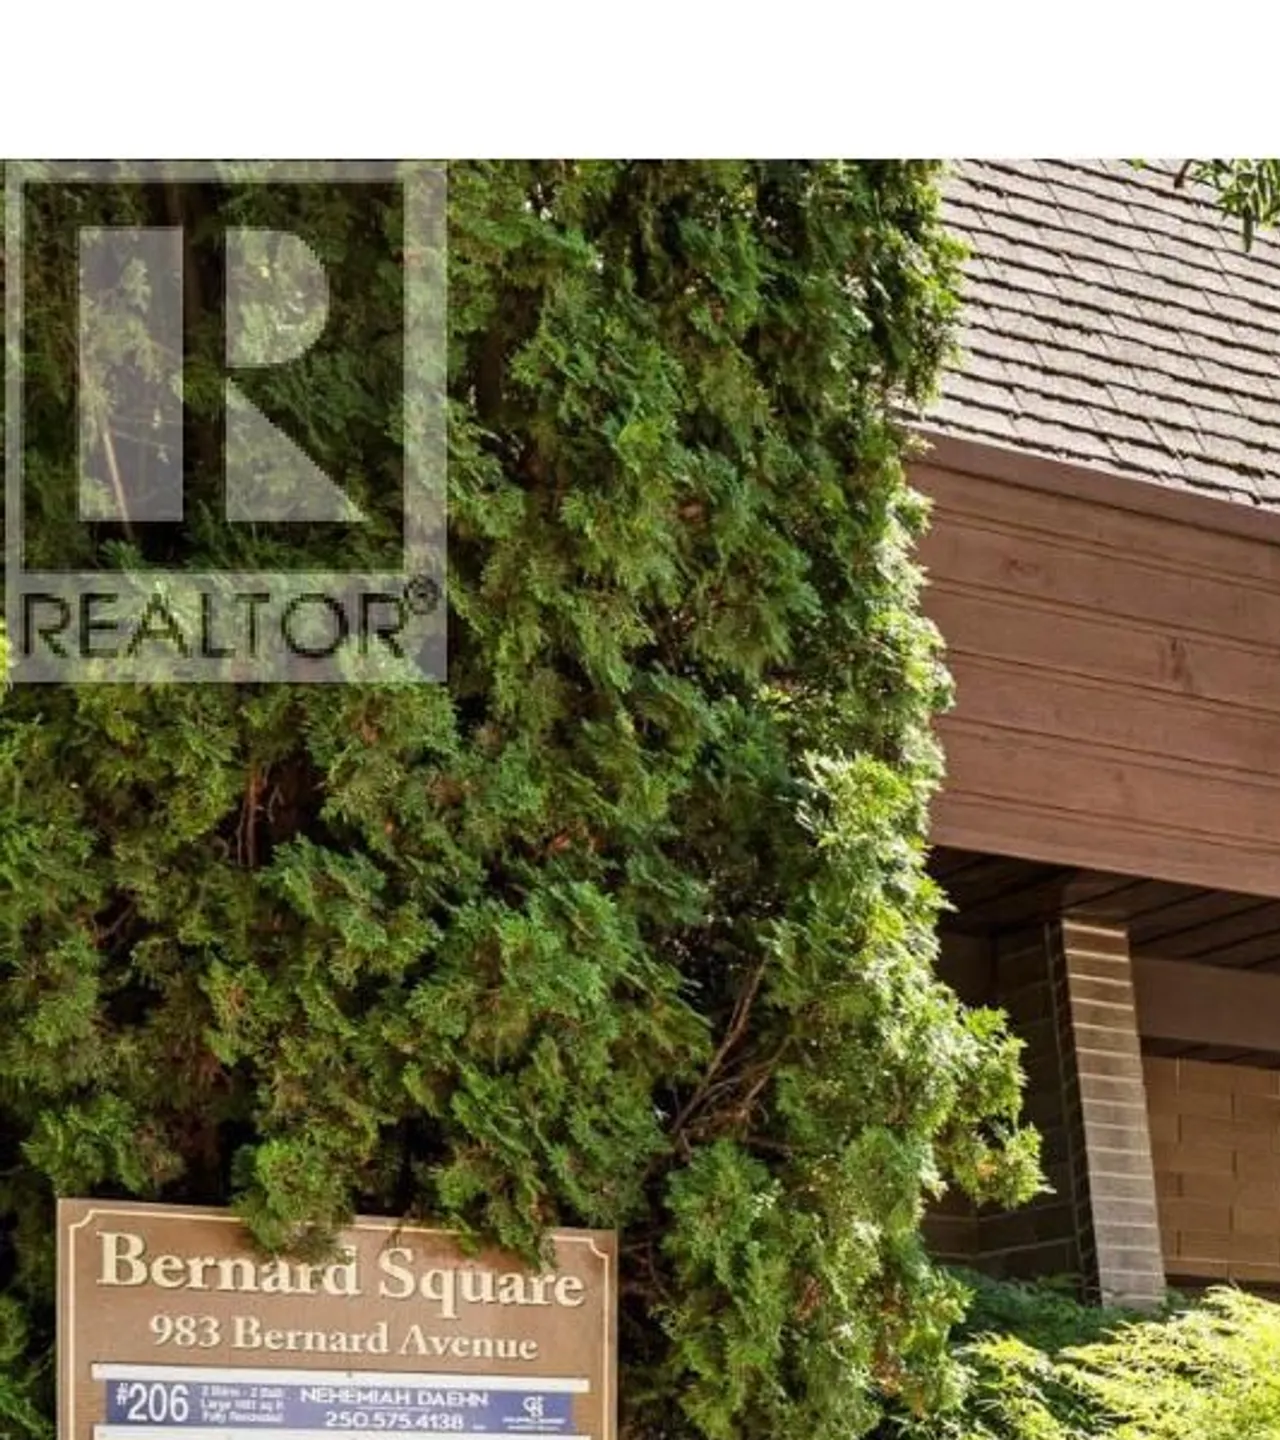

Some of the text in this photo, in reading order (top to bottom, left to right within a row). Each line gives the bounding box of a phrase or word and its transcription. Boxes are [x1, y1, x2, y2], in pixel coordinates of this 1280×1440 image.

[96, 1230, 586, 1320] Bernard Square
[150, 1313, 539, 1361] 983 Bernard Avenue
[116, 1382, 190, 1422] #206
[300, 1387, 489, 1407] NEHEMIAH DAEHN
